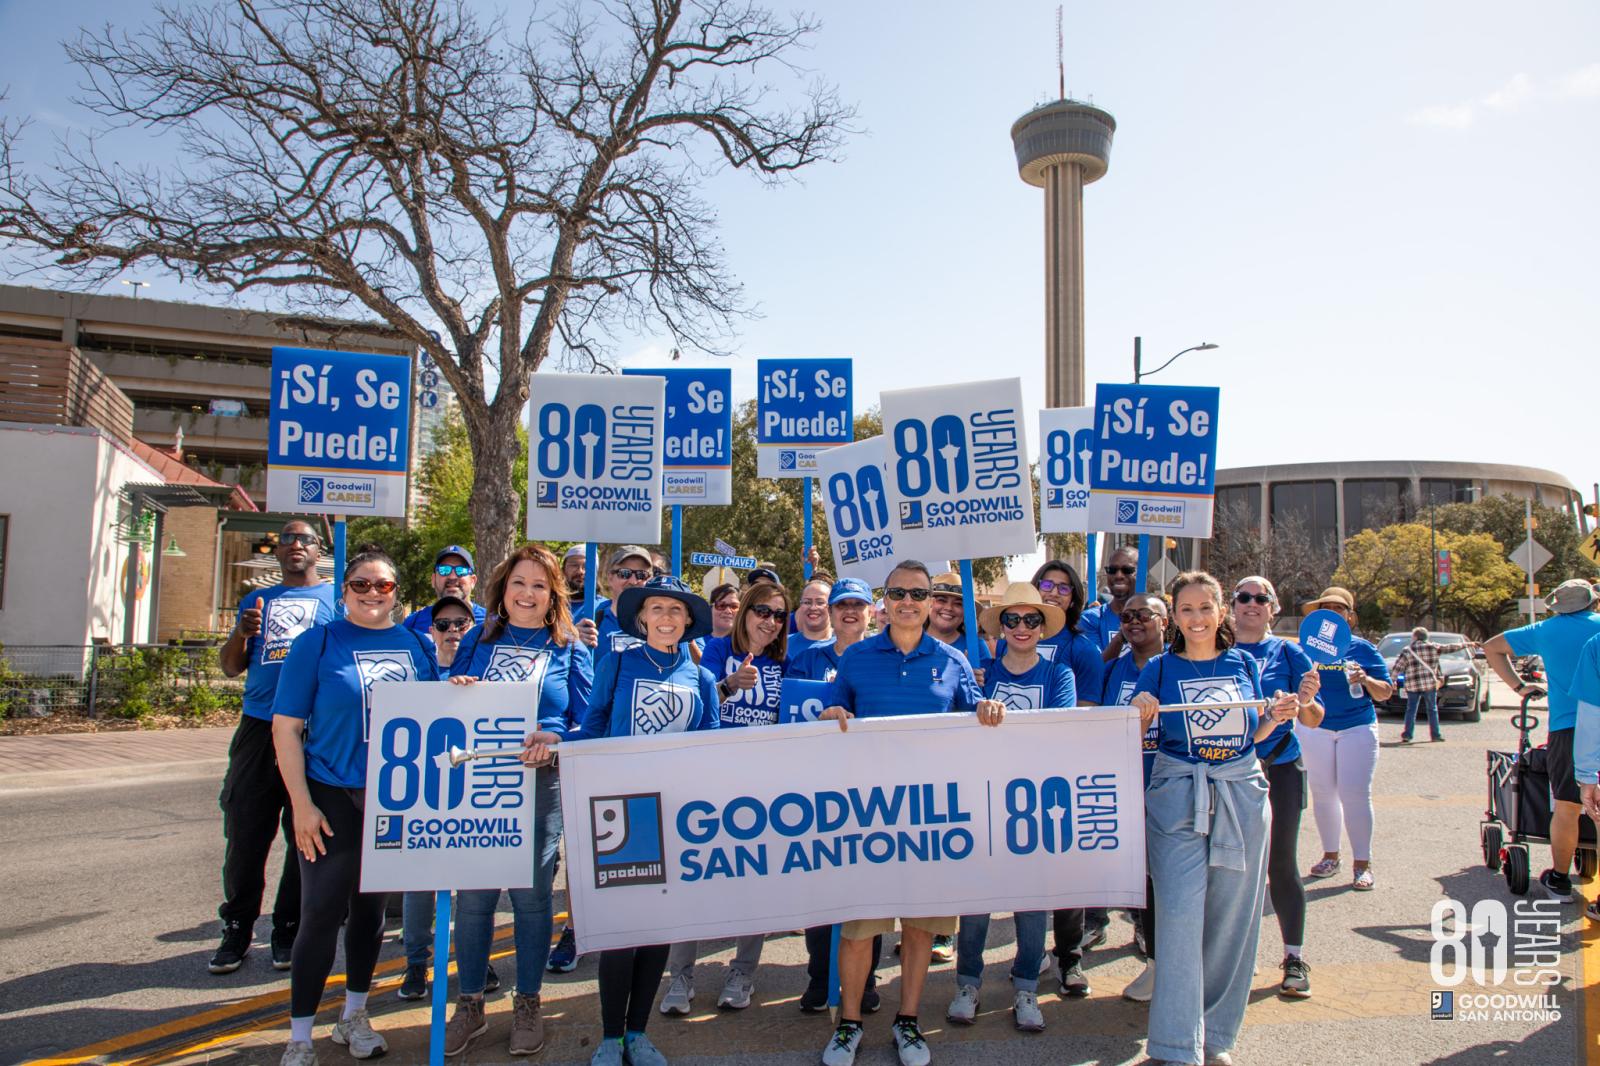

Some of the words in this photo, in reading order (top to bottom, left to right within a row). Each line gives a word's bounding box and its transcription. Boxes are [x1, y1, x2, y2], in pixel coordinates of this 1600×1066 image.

[279, 364, 340, 411] ¡Sí,
[355, 369, 400, 410] Se
[687, 381, 724, 414] Se
[763, 369, 805, 403] ¡Sí,
[814, 369, 847, 398] Se
[764, 411, 847, 437] Puede!
[1101, 398, 1155, 440] ¡Sí,
[1168, 399, 1209, 437] Se
[279, 421, 398, 462] Puede!
[537, 402, 606, 480] 80
[610, 406, 655, 481] YEARS
[665, 428, 724, 458] ede!
[894, 414, 969, 498] 80
[970, 409, 1021, 490] YEARS
[1047, 428, 1094, 486] 80
[1100, 449, 1208, 486] Puede!
[326, 492, 372, 503] CARES
[327, 481, 372, 491] Goodwill
[561, 485, 652, 501] GOODWILL
[667, 485, 704, 494] CARES
[828, 464, 889, 537] 80
[561, 500, 588, 510] SAN
[592, 501, 652, 512] ANTONIO
[926, 496, 1023, 516] GOODWILL
[927, 516, 955, 528] SAN
[960, 510, 1024, 525] ANTONIO
[1140, 513, 1181, 524] CARES
[1141, 503, 1182, 513] Goodwill
[693, 554, 697, 563] E
[699, 554, 723, 565] CESAR
[724, 557, 755, 568] CHAVEZ
[861, 548, 883, 561] SAN
[1194, 737, 1241, 747] Goodwill
[378, 717, 467, 811] 80
[407, 818, 522, 835] GOODWILL
[676, 781, 971, 844] GOODWILL
[1005, 776, 1074, 856] 80
[1076, 773, 1119, 851] YEARS
[407, 836, 441, 849] SAN
[446, 835, 523, 848] ANTONIO
[680, 846, 768, 882] SAN
[781, 827, 975, 875] ANTONIO
[598, 863, 661, 886] goodwill
